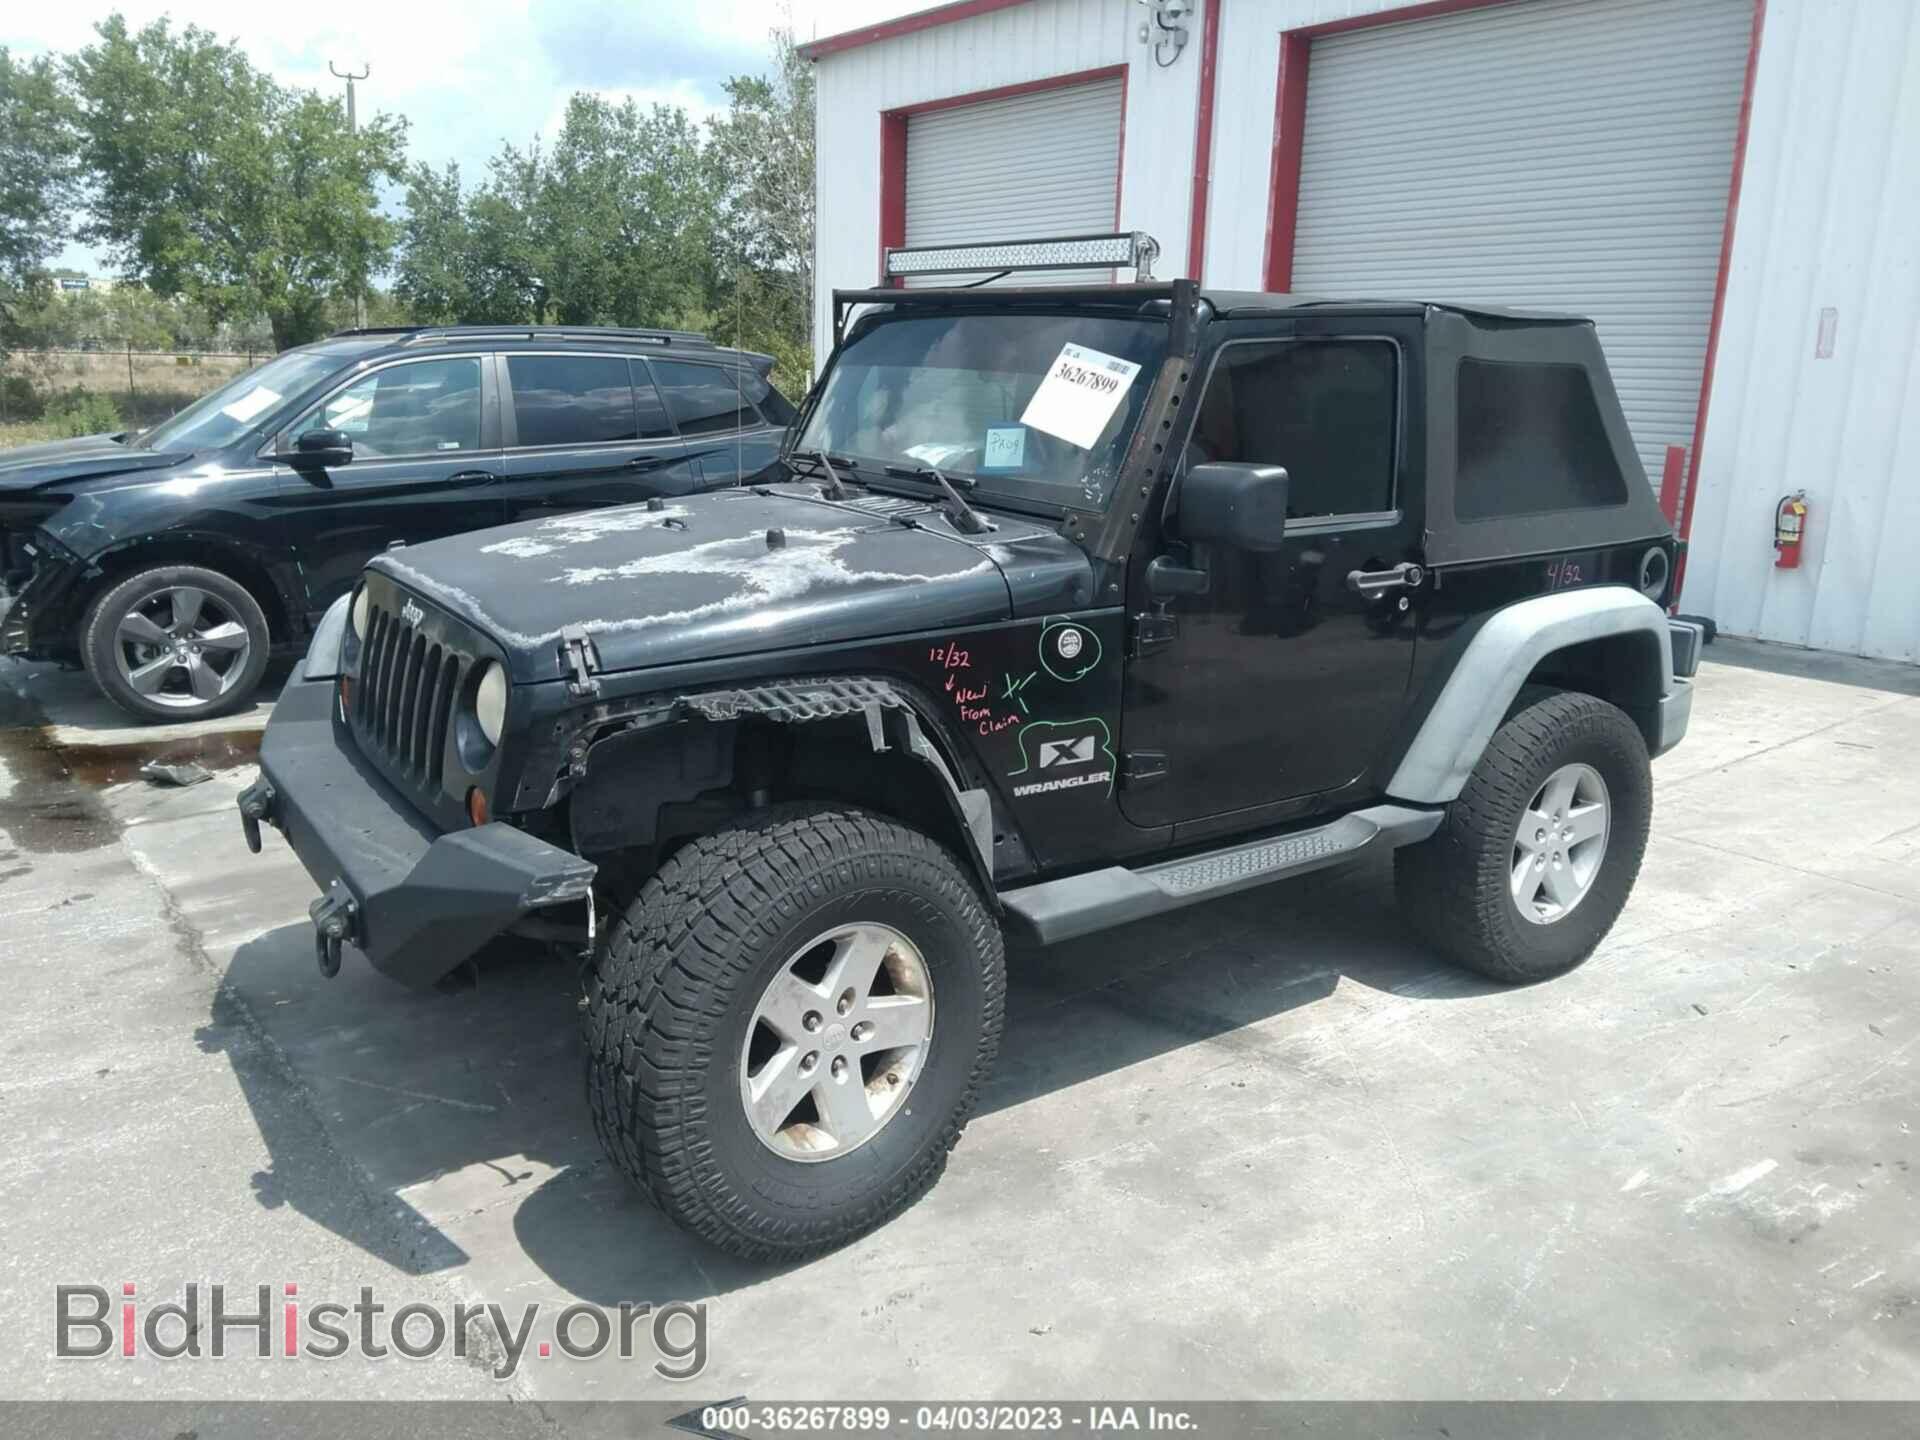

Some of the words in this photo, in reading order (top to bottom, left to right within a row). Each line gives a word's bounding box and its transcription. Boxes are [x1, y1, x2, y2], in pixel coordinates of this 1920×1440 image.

[1055, 362, 1119, 394] 36267899
[401, 598, 424, 629] Jeep
[928, 642, 971, 669] 12/32
[955, 684, 988, 704] New
[960, 706, 992, 721] From
[979, 714, 1020, 736] Claim
[1042, 736, 1092, 768] X
[1013, 771, 1112, 797] WRANGLER
